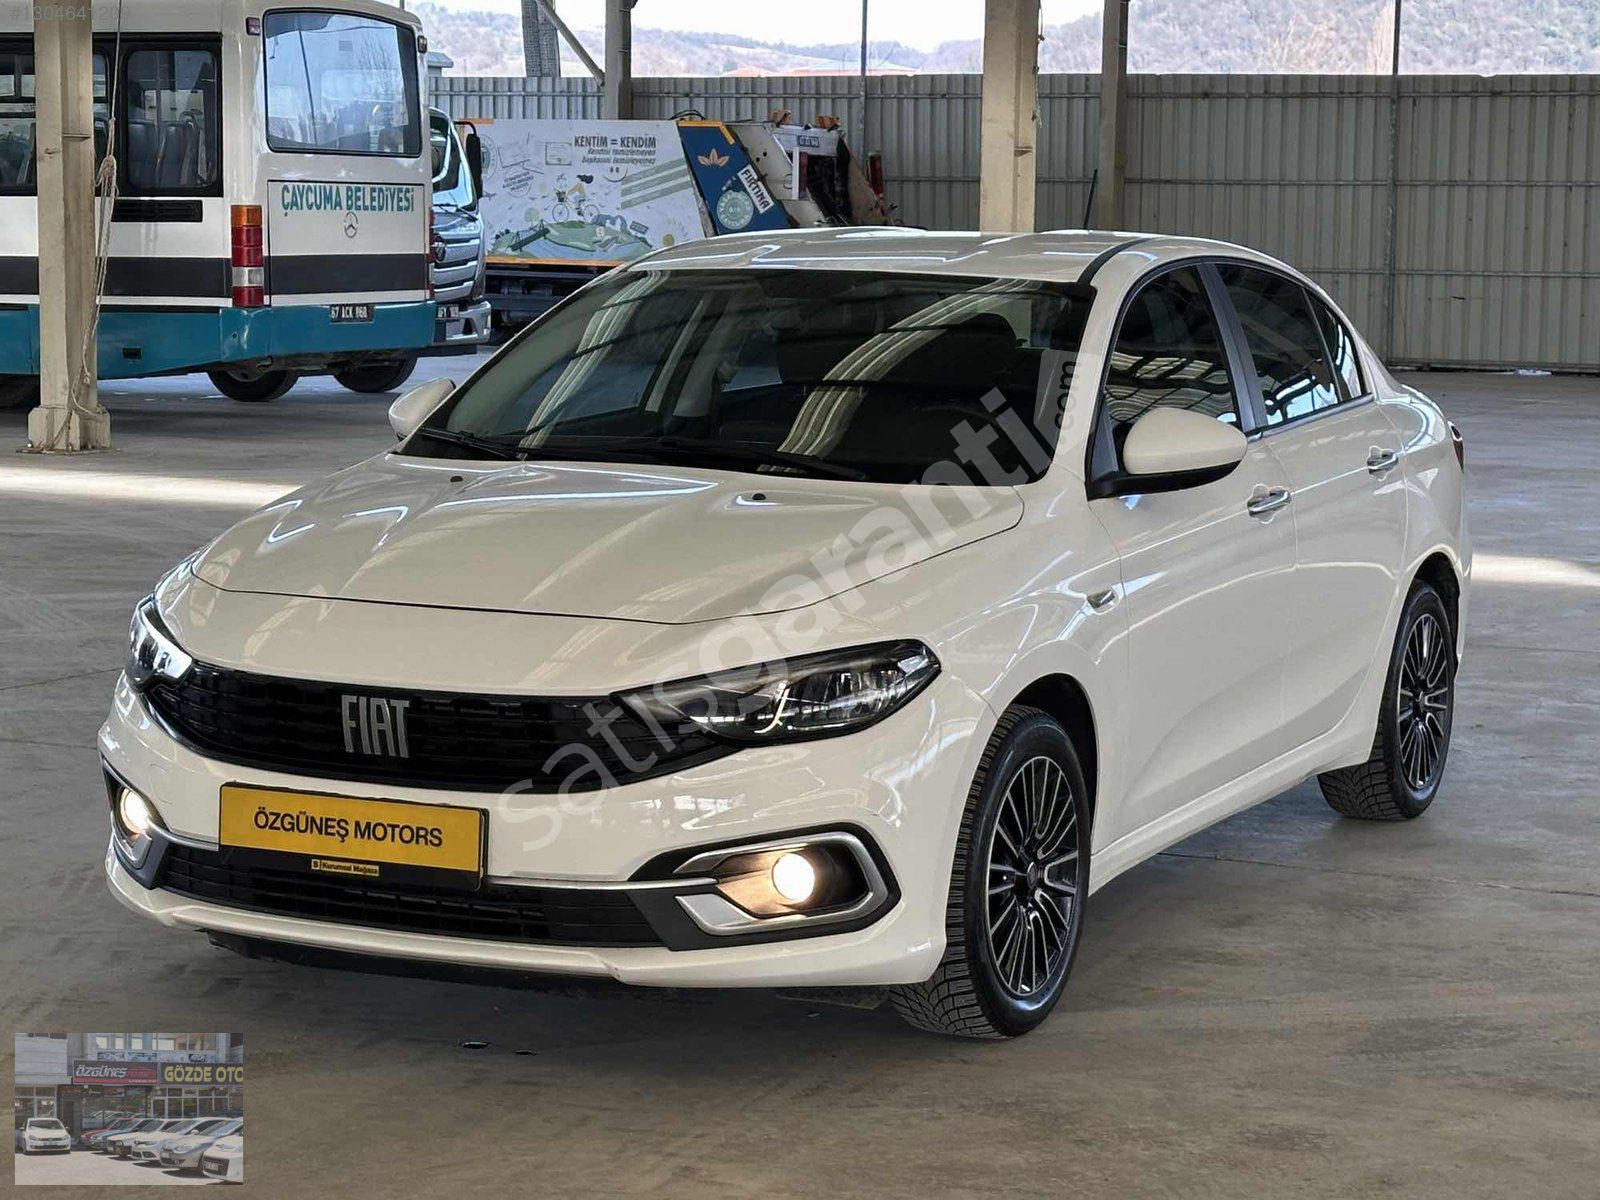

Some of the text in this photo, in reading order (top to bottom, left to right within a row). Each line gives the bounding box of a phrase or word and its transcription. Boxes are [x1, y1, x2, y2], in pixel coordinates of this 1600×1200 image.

[281, 184, 343, 217] ÇAYCUMA
[341, 694, 409, 759] FIAT
[253, 806, 444, 849] ÖZGÜNEŞ MOTORS
